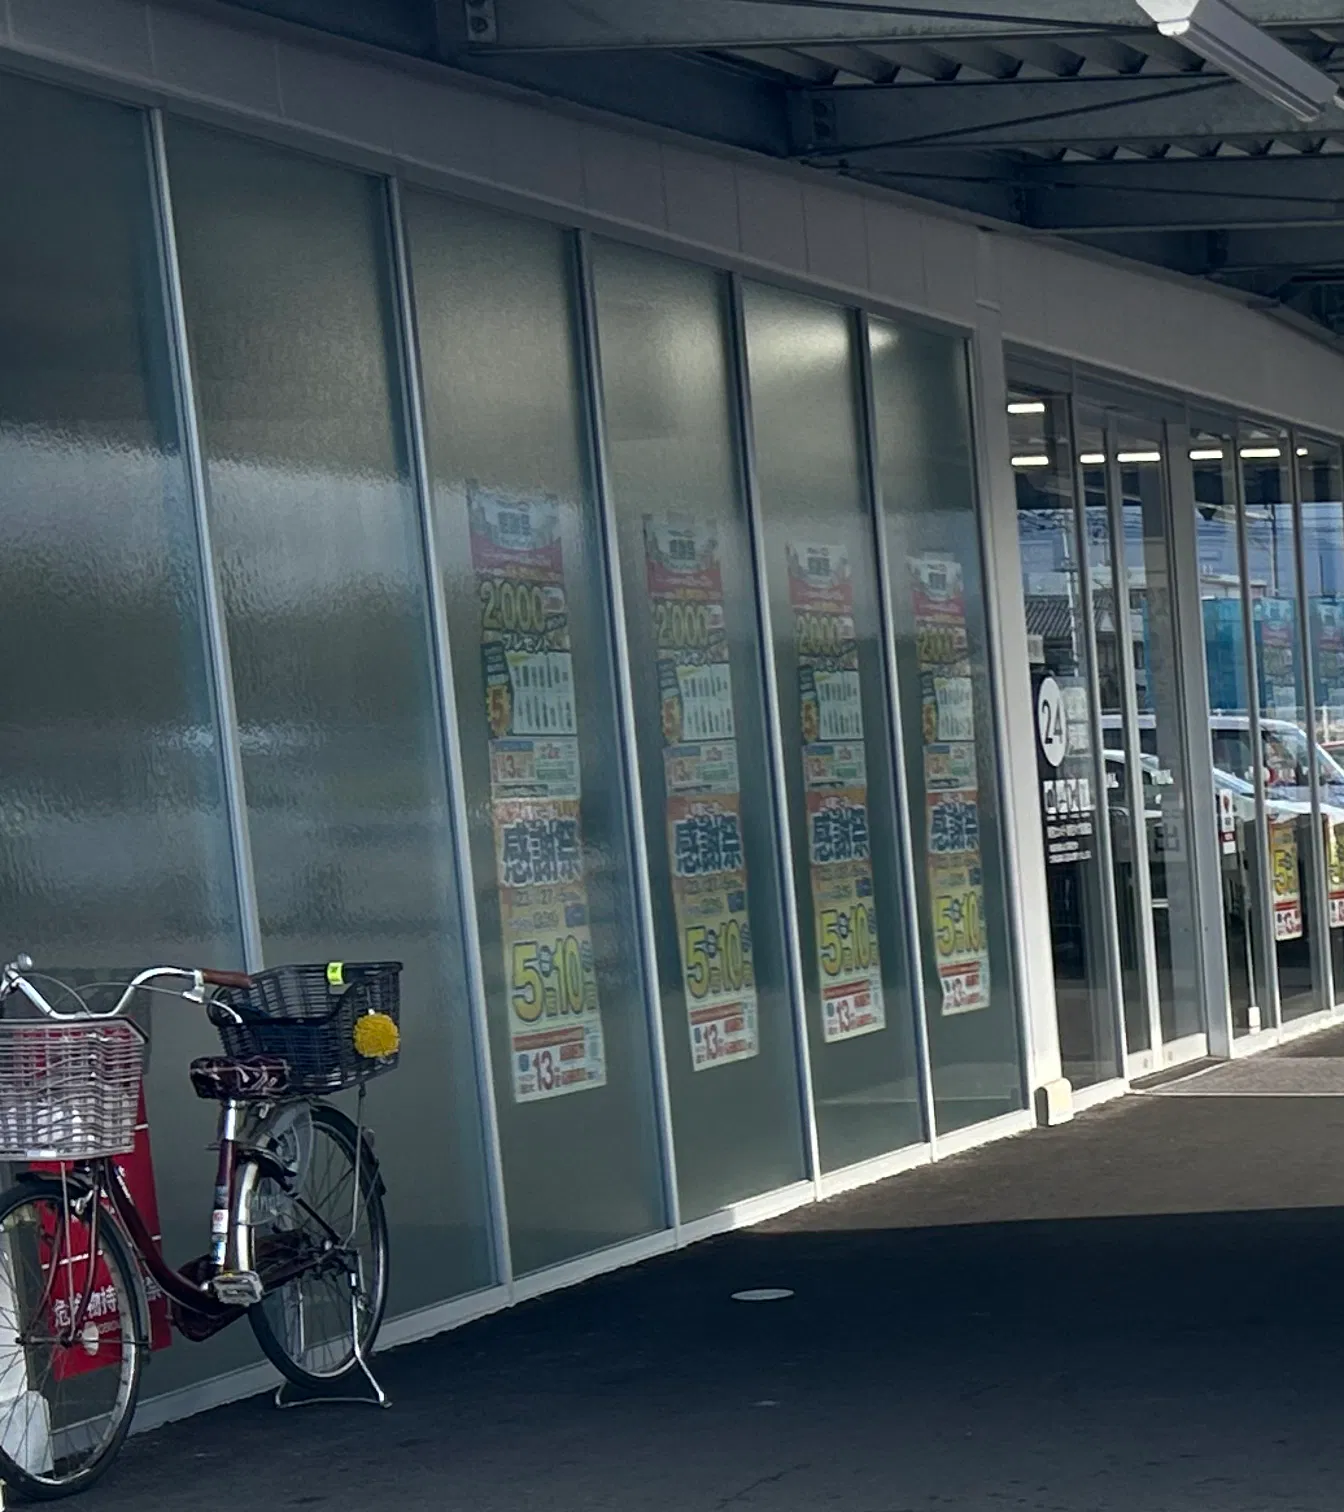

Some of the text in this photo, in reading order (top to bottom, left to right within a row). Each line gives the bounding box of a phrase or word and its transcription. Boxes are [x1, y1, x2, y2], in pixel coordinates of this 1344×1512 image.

[1042, 698, 1063, 745] 24
[503, 818, 580, 885] 感謝祭
[674, 812, 743, 877] 感謝祭
[811, 805, 870, 863] 感謝祭
[930, 801, 979, 853] 感謝祭
[685, 918, 743, 999] 5 10
[820, 909, 842, 977] 5
[936, 895, 955, 957] 5
[512, 935, 584, 1023] 5 10
